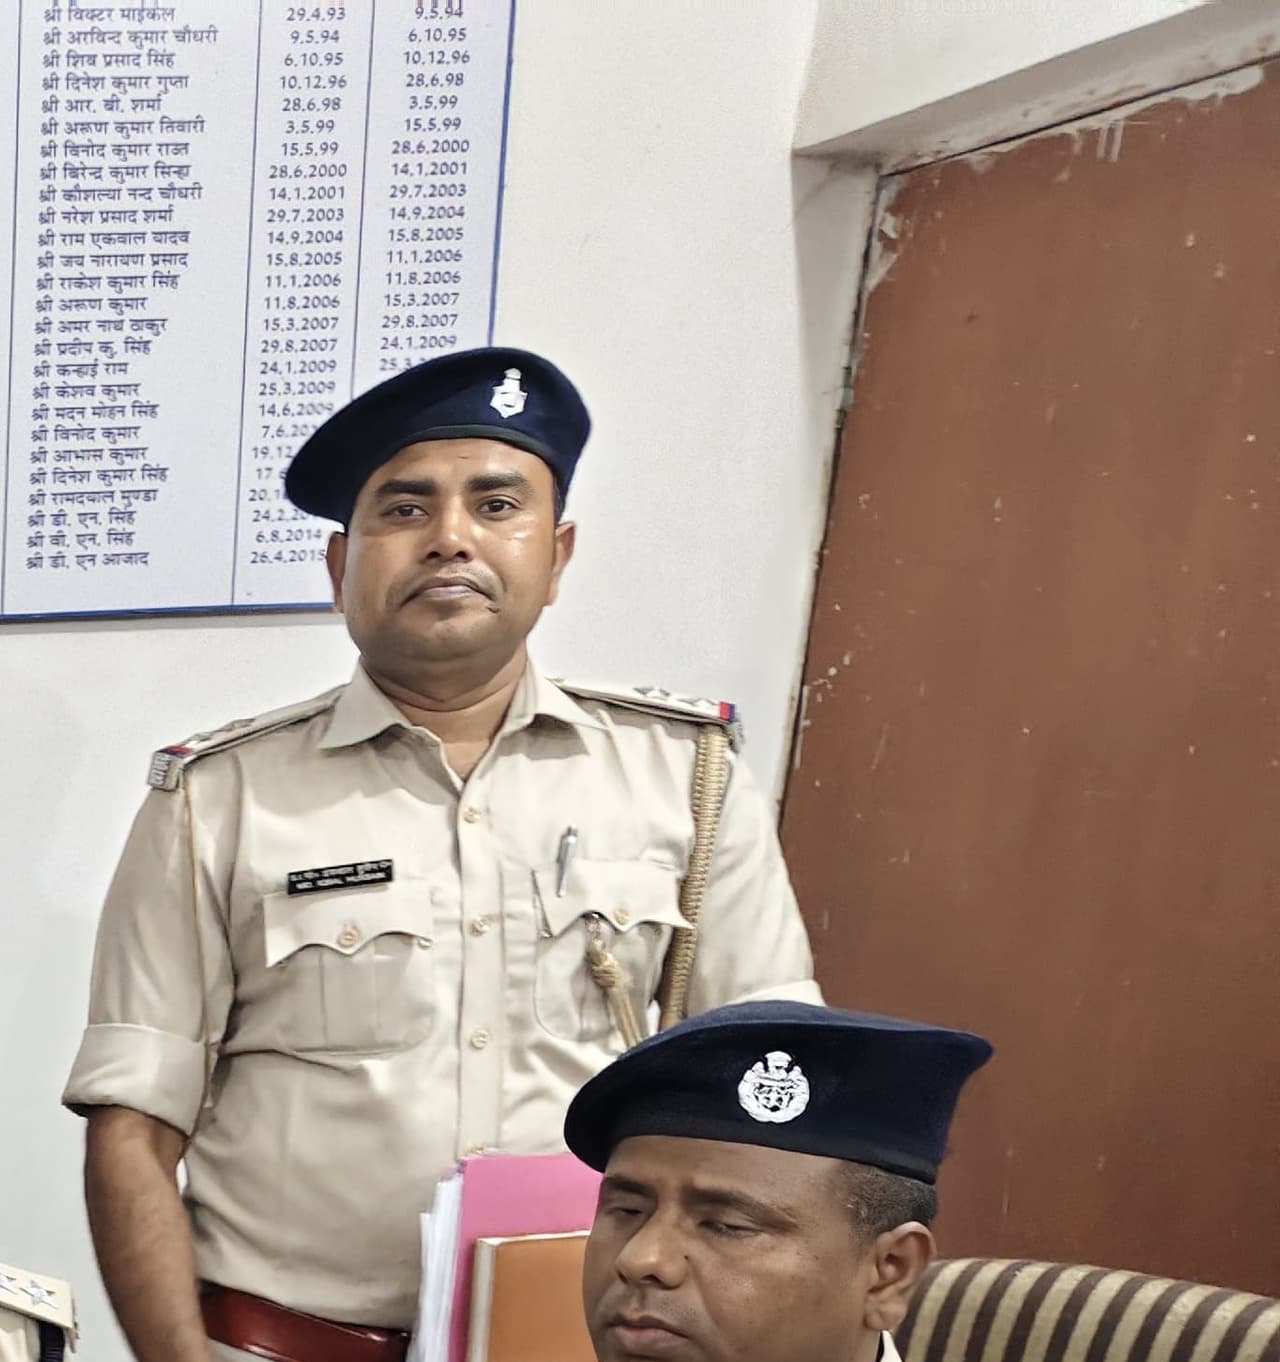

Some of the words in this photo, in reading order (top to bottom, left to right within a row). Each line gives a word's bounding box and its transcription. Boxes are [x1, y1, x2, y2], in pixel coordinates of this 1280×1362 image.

[44, 7, 63, 22] श्री
[286, 8, 346, 22] 29.4.93
[43, 26, 62, 46] श्री
[67, 26, 122, 46] अरविन्द
[126, 30, 168, 50] कुमार
[172, 24, 219, 43] चौधरी
[290, 30, 340, 44] 9.5.94
[408, 27, 466, 43] 6.10.95
[42, 49, 61, 68] श्री
[65, 49, 98, 69] शिव
[102, 53, 142, 68] प्रसाद
[146, 48, 176, 68] सिंह
[284, 52, 343, 68] 6.10.95
[403, 50, 470, 66] 10.12.96
[42, 72, 61, 91] श्री
[65, 71, 106, 91] दिनेश
[110, 76, 152, 95] कुमार
[157, 75, 190, 95] गुप्ता
[280, 75, 347, 90] 10.12.96
[406, 72, 464, 88] 28.6.98
[41, 94, 60, 114] श्री
[65, 99, 96, 114] आर.
[131, 93, 162, 113] शर्मा
[282, 97, 342, 112] 28.6.98
[409, 95, 458, 110] 3.5.99
[40, 116, 60, 136] श्री
[113, 120, 155, 140] कुमार
[159, 114, 206, 134] तिवारी
[285, 120, 335, 134] 3.5.99
[404, 117, 462, 132] 15.5.99
[40, 139, 58, 158] श्री
[62, 138, 107, 160] विनोद
[110, 143, 152, 162] कुमार
[281, 141, 339, 156] 15.5.99
[392, 139, 470, 155] 28.6.2000
[40, 161, 58, 180] श्री
[108, 165, 150, 184] कुमार
[268, 164, 347, 179] 28.6.2000
[392, 161, 467, 177] 14.1.2001
[38, 184, 58, 203] श्री
[126, 187, 154, 202] नन्द
[157, 182, 204, 200] चौधरी
[269, 186, 344, 202] 14.1.2001
[389, 183, 467, 199] 29.7.2003
[38, 206, 57, 225] श्री
[60, 205, 95, 225] नरेश
[98, 210, 139, 224] प्रसाद
[142, 204, 174, 224] शर्मा
[266, 208, 344, 224] 29.7.2003
[390, 206, 465, 220] 14.9.2004
[37, 228, 56, 247] श्री
[59, 233, 86, 246] राम
[267, 230, 344, 246] 14.9.2004
[388, 227, 463, 243] 15.8.2005
[36, 250, 55, 269] श्री
[89, 253, 146, 267] नारायण
[149, 252, 189, 268] प्रसाद
[266, 251, 342, 267] 15.8.2005
[386, 249, 463, 264] 11.1.2006
[36, 272, 55, 292] श्री
[58, 272, 104, 290] राकेश
[106, 275, 148, 294] कुमार
[151, 270, 180, 290] सिंह
[266, 272, 341, 288] 11.1.2006
[386, 270, 461, 286] 11.8.2006
[35, 294, 54, 313] श्री
[106, 297, 148, 316] कुमार
[264, 295, 340, 310] 11.8.2006
[384, 292, 460, 308] 15.3.2007
[34, 316, 54, 334] श्री
[57, 320, 92, 333] अमर
[128, 318, 168, 336] ठाकुर
[264, 316, 339, 332] 15.3.2007
[382, 313, 458, 329] 29.8.2007
[33, 338, 52, 356] श्री
[56, 337, 94, 358] प्रदीप
[123, 336, 152, 355] सिंह
[261, 338, 338, 354] 29.8.2007
[380, 335, 457, 350] 24.1.2009
[32, 381, 51, 400] श्री
[100, 383, 142, 402] कुमार
[259, 381, 336, 396] 25.3.2009
[32, 403, 50, 421] श्री
[53, 406, 88, 422] मदन
[130, 400, 160, 418] सिंह
[26, 552, 44, 569] श्री
